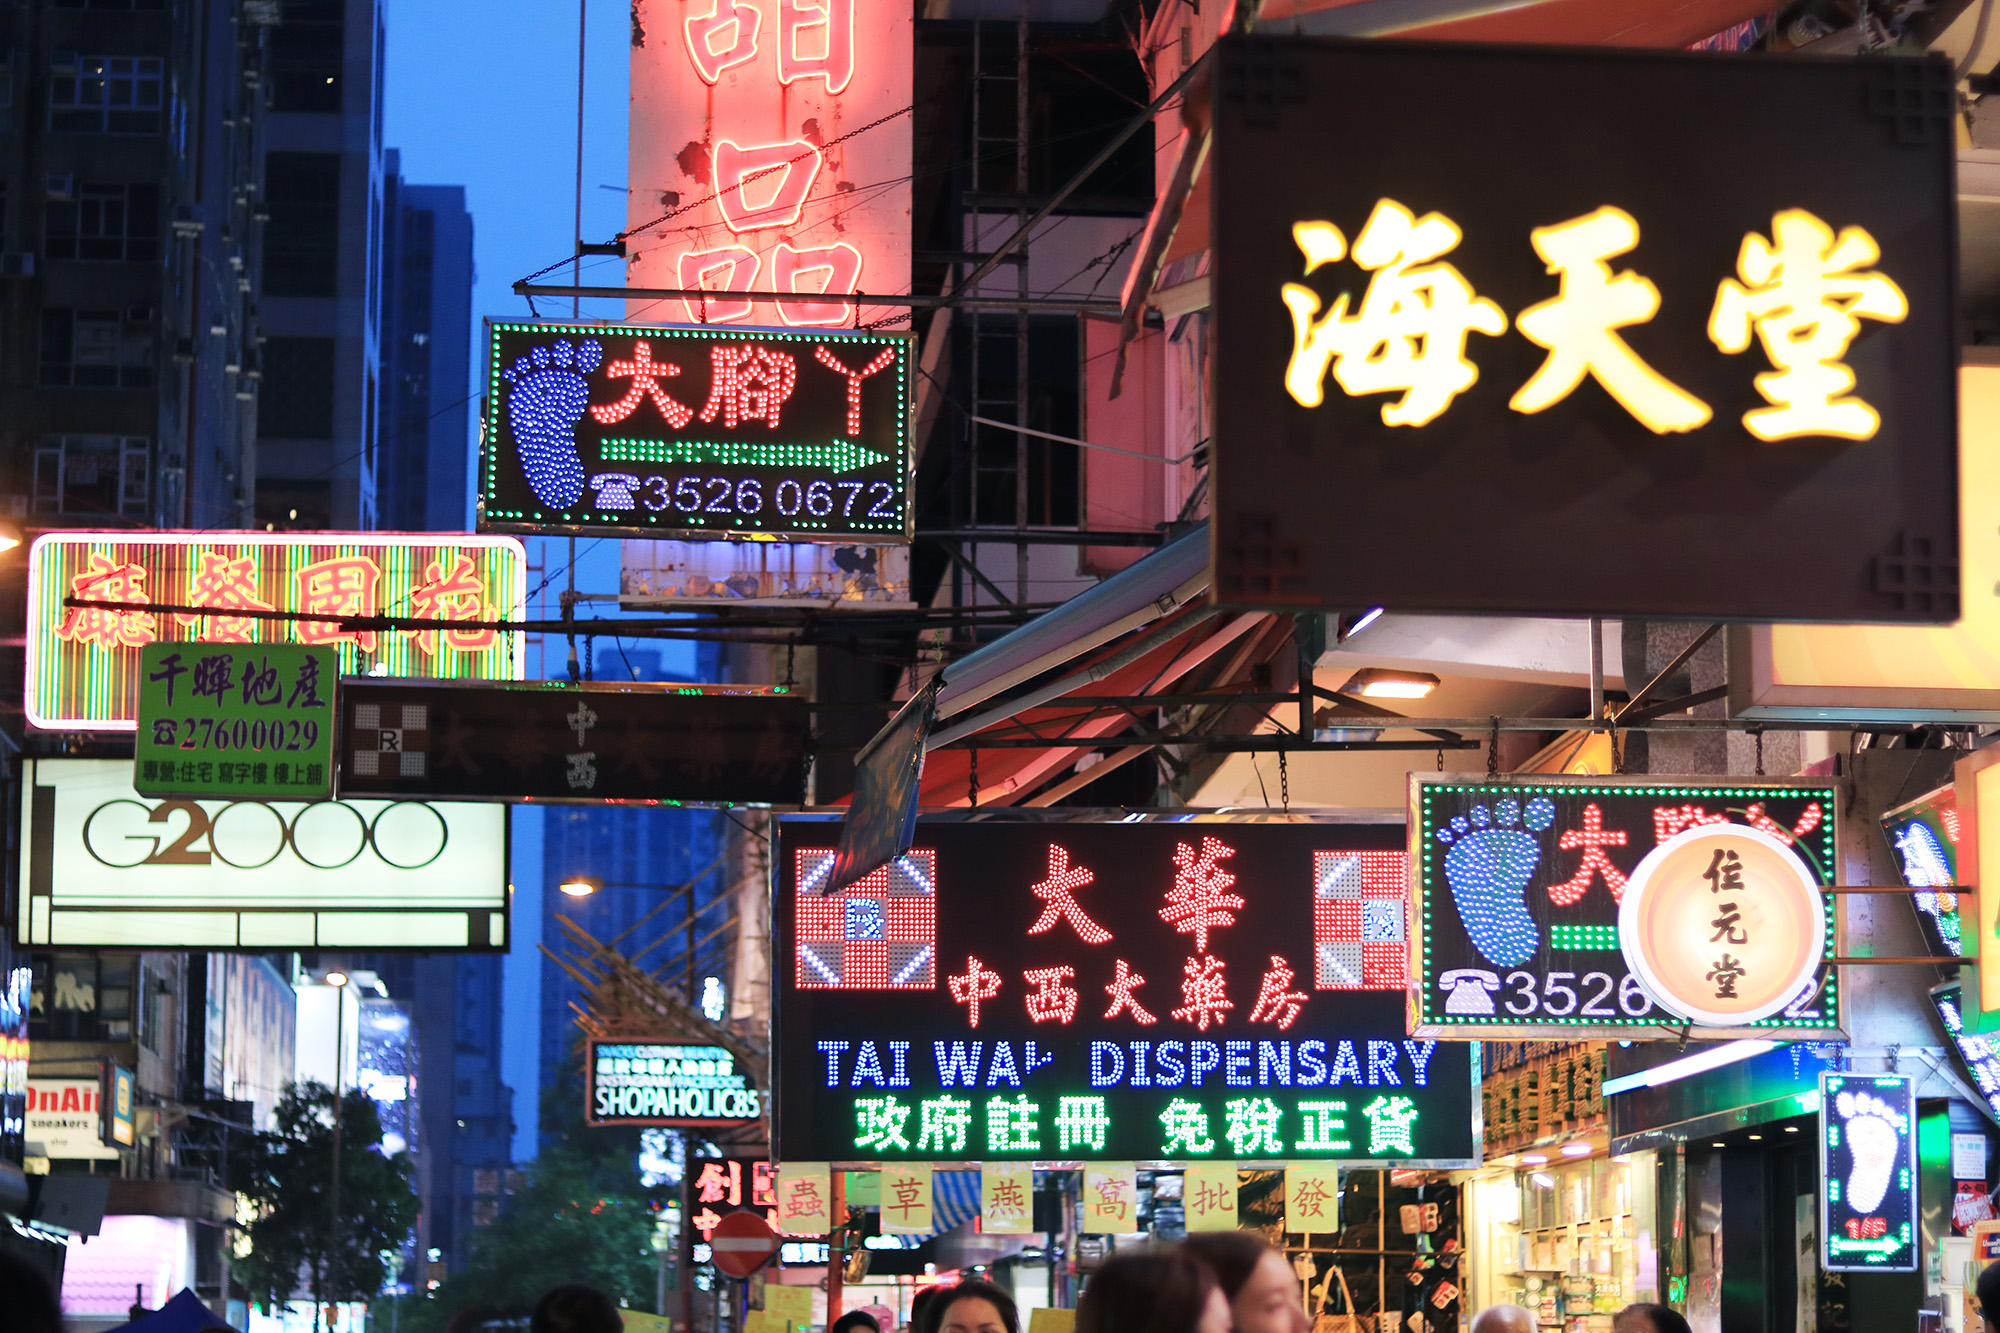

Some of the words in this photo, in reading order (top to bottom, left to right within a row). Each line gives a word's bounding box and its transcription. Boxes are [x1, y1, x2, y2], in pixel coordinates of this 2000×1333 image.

[1282, 198, 1909, 442] 海天堂
[643, 475, 763, 514] 3526
[775, 480, 895, 517] 0672
[179, 717, 319, 752] 27600029
[83, 800, 448, 868] G2000
[1026, 835, 1245, 953] 大華
[1503, 970, 1653, 1017] 3526
[817, 1040, 911, 1087] TAI
[1091, 1039, 1437, 1087] DISPENSARY
[31, 1118, 89, 1129] sneakers
[854, 1095, 1111, 1151] 政府註冊
[887, 1176, 926, 1221] 草
[990, 1178, 1026, 1220] 燕
[1191, 1180, 1234, 1216] 批
[1292, 1177, 1333, 1219] 發
